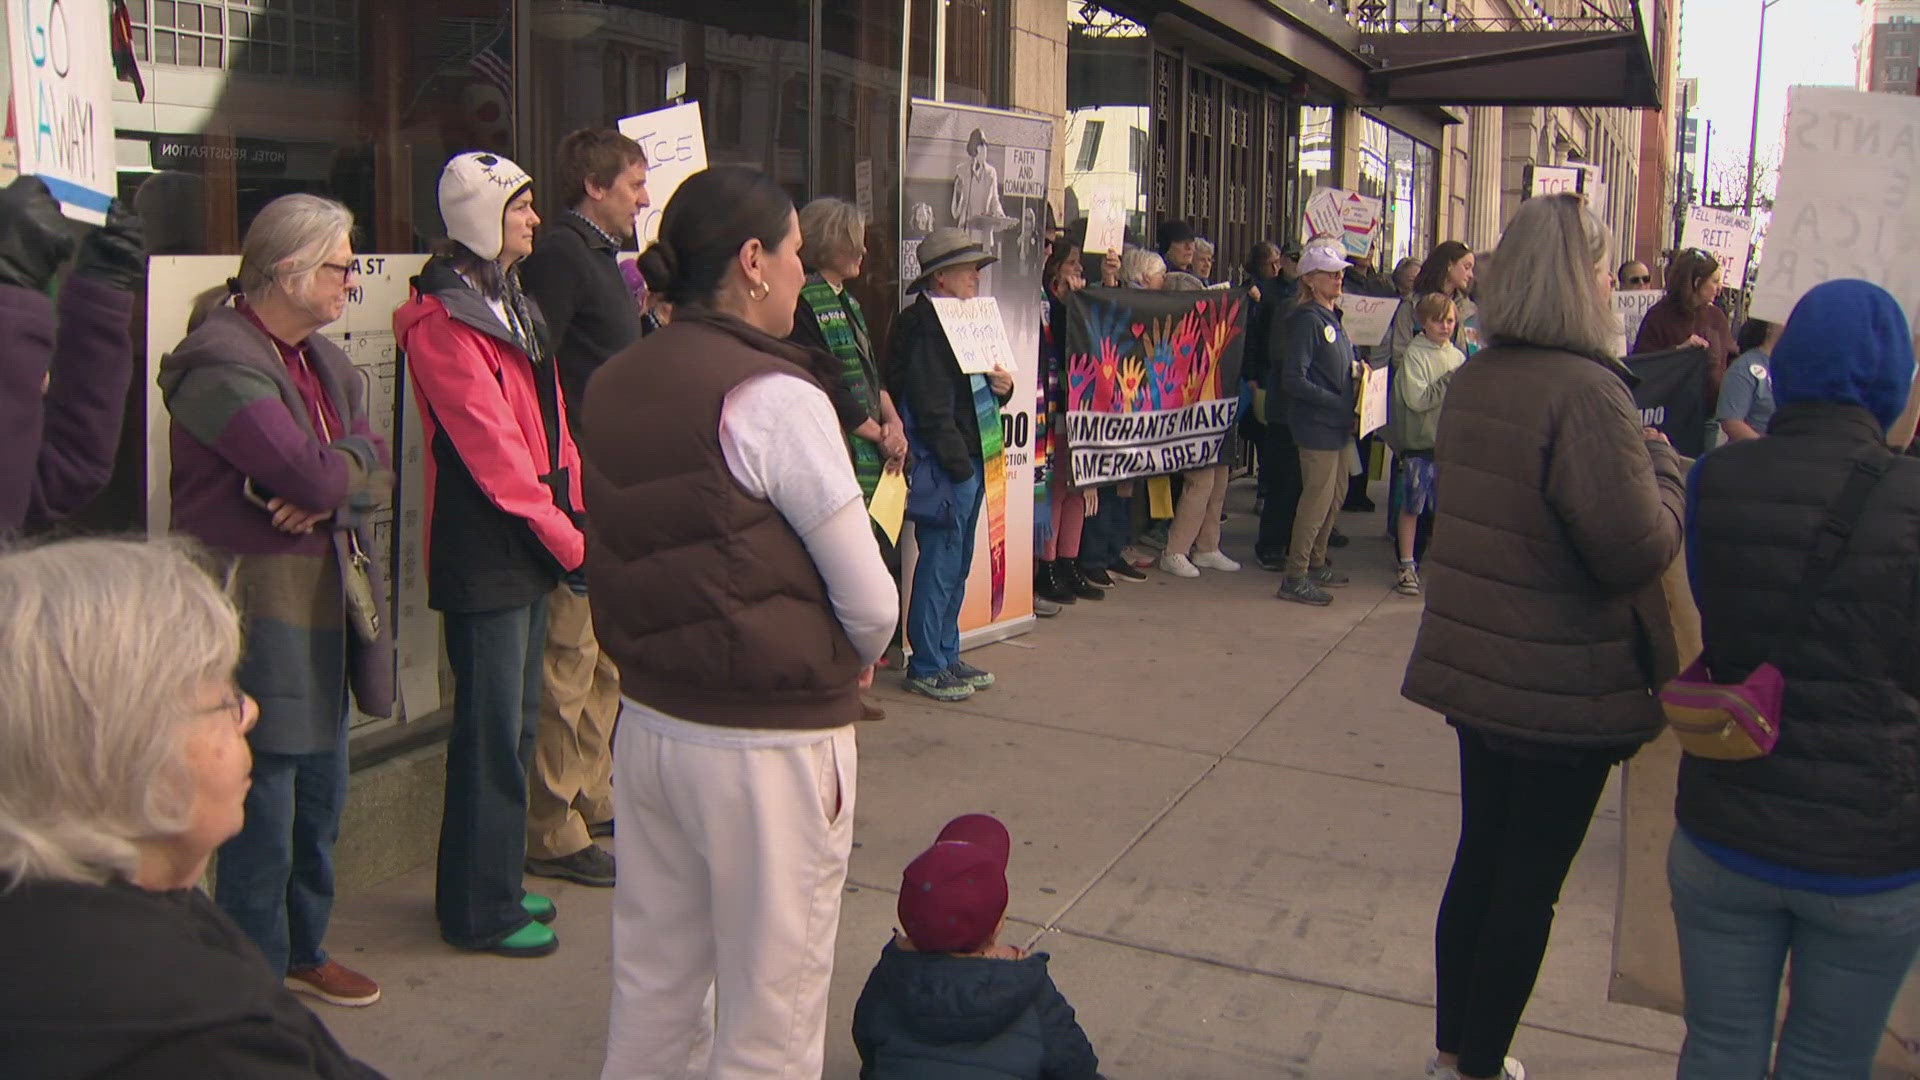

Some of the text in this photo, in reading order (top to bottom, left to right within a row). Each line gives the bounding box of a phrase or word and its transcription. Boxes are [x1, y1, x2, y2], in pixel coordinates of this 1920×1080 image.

[26, 0, 70, 78] GO
[38, 79, 95, 183] AWAY!
[636, 131, 693, 171] ICE
[1013, 149, 1036, 165] FAITH
[1018, 165, 1034, 180] AND
[1005, 179, 1044, 195] COMMUNITY
[1691, 205, 1750, 231] TELL HIGHLANDS
[1701, 228, 1734, 248] REIT:
[904, 241, 918, 253] DI
[366, 258, 385, 275] ST
[904, 267, 921, 278] PEO
[1355, 299, 1386, 314] OUT
[1618, 295, 1635, 309] NO
[1179, 402, 1237, 433] MAKE
[1001, 411, 1029, 448] DO
[1004, 453, 1027, 466] CTION
[1075, 439, 1223, 481] AMERICA GREAT
